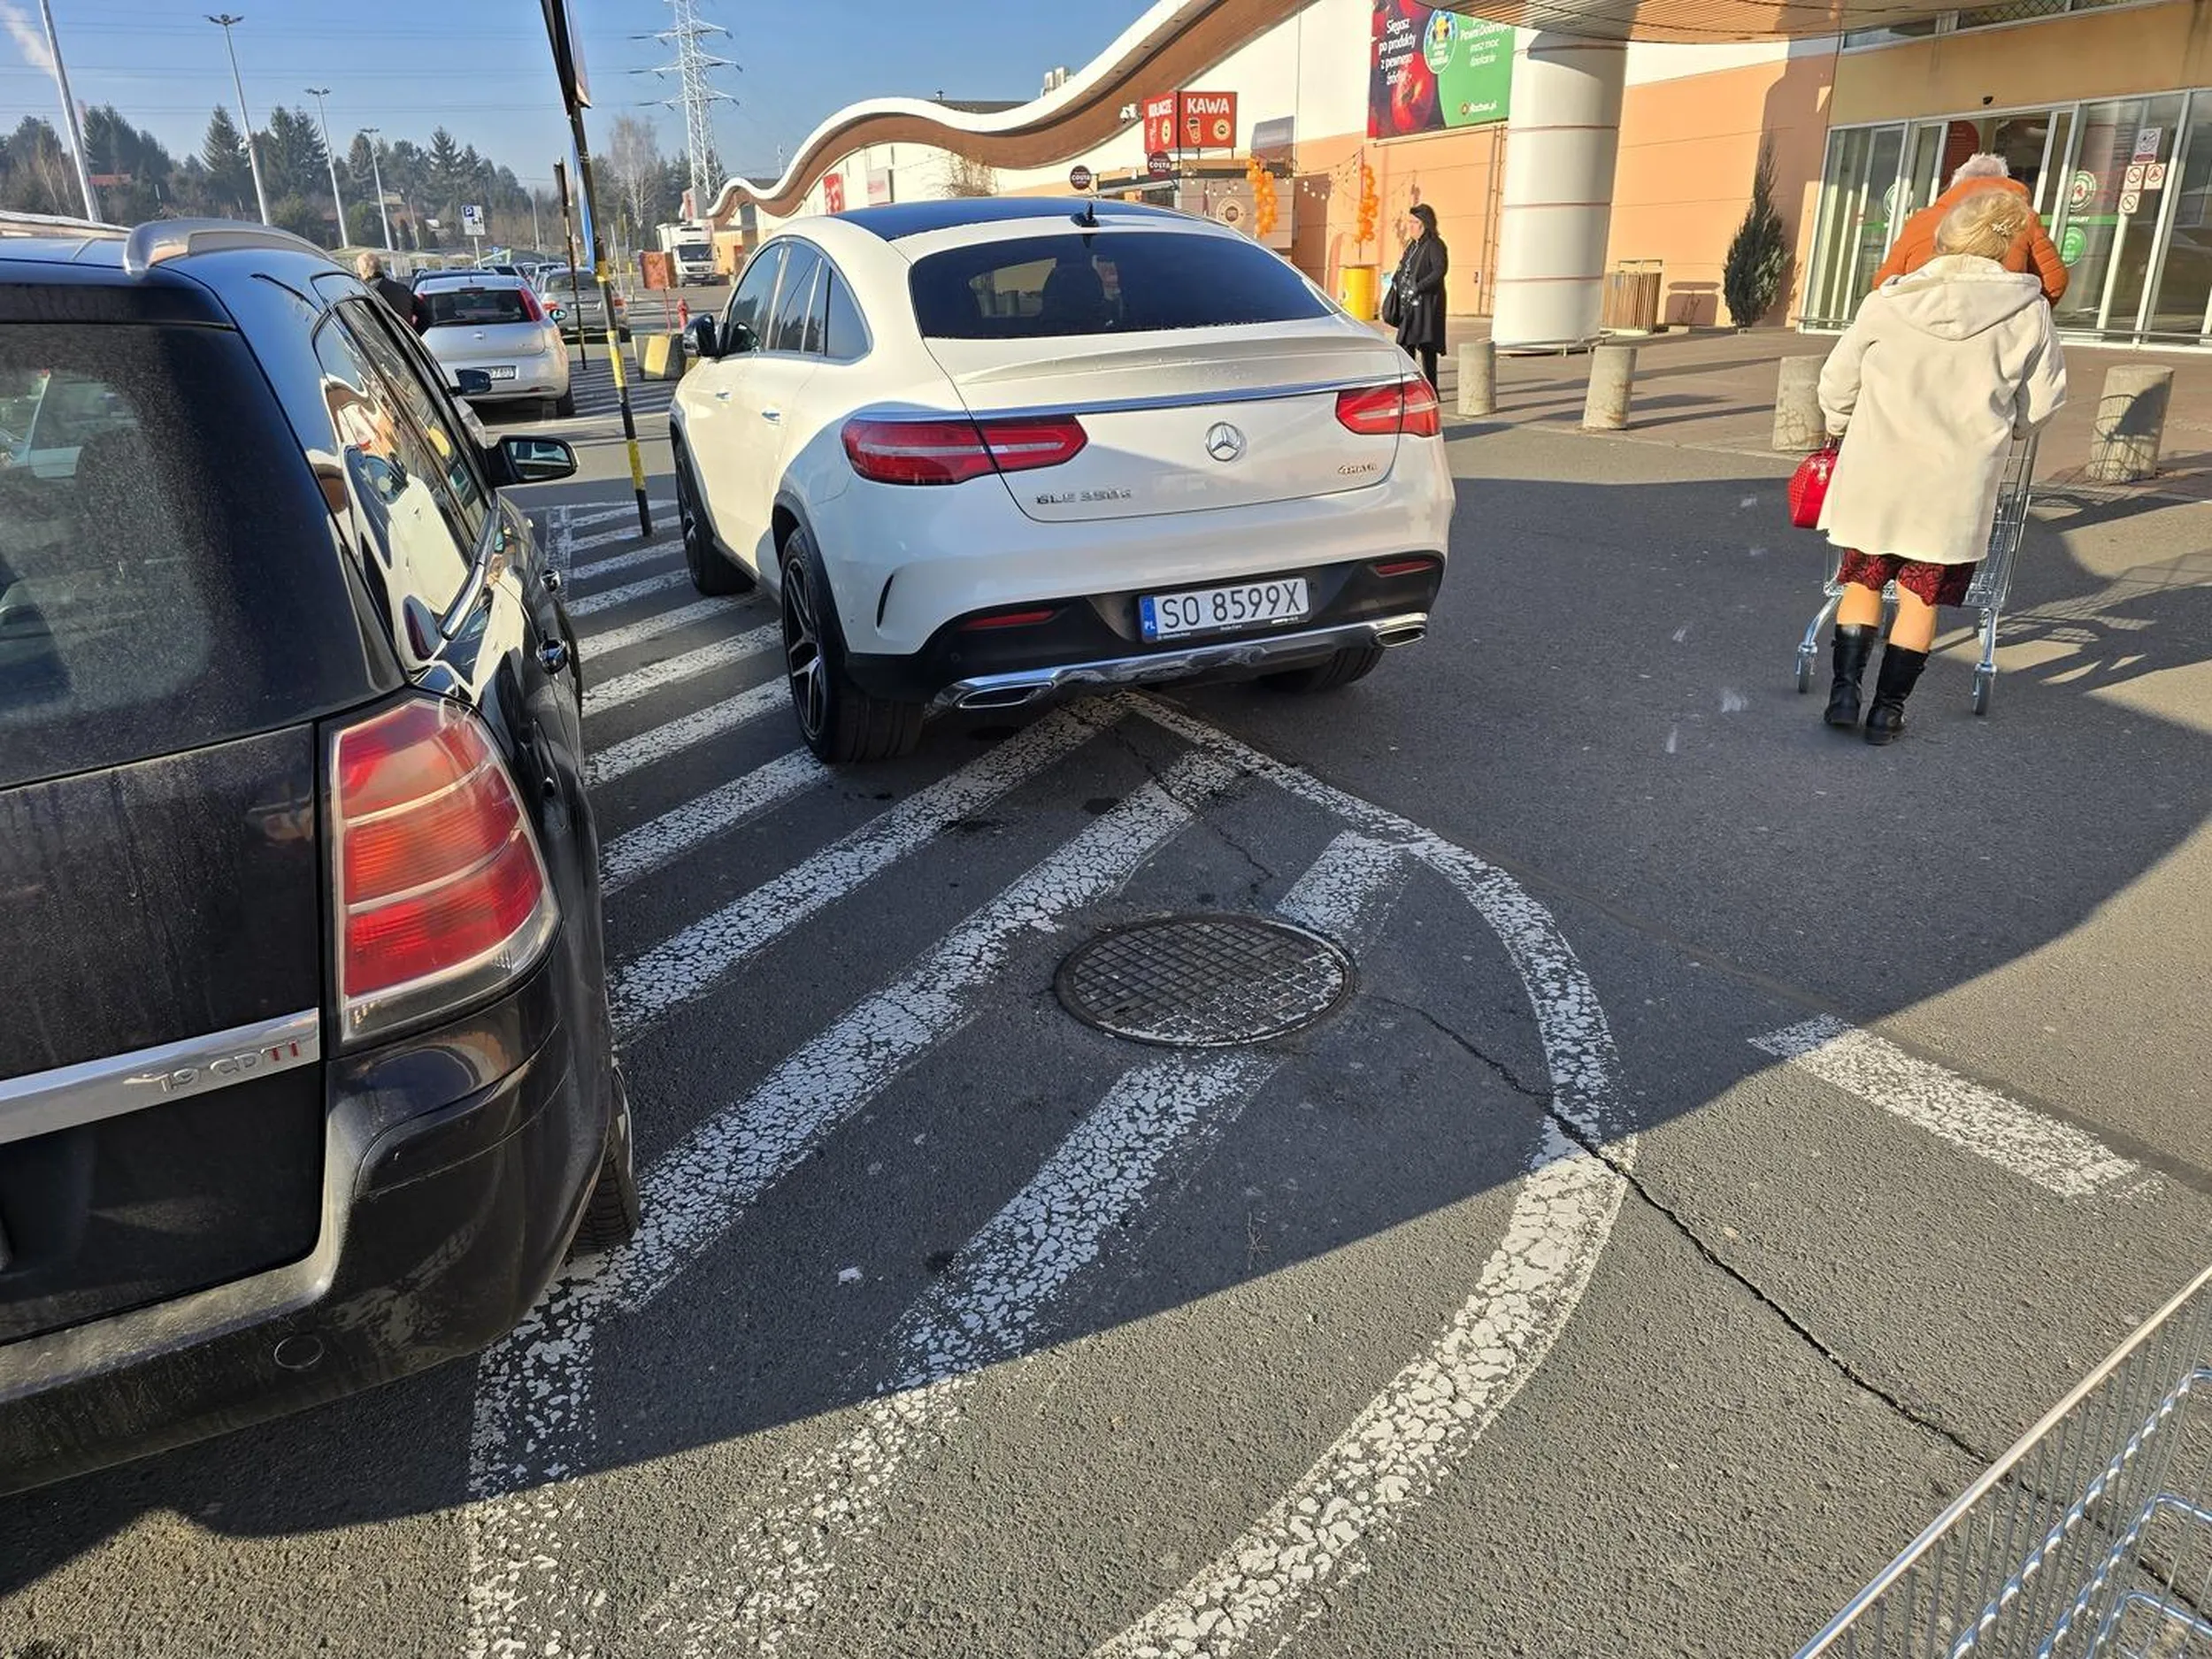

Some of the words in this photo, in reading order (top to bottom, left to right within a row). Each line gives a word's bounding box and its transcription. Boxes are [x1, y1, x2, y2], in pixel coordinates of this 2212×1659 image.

[1379, 42, 1387, 56] po
[1388, 33, 1416, 54] produkty
[1187, 97, 1230, 114] KAWA
[1036, 493, 1076, 504] GLE
[1162, 596, 1201, 629] SO
[1211, 581, 1301, 622] 8599X
[1144, 620, 1156, 630] PL
[209, 1040, 301, 1077] CDTI
